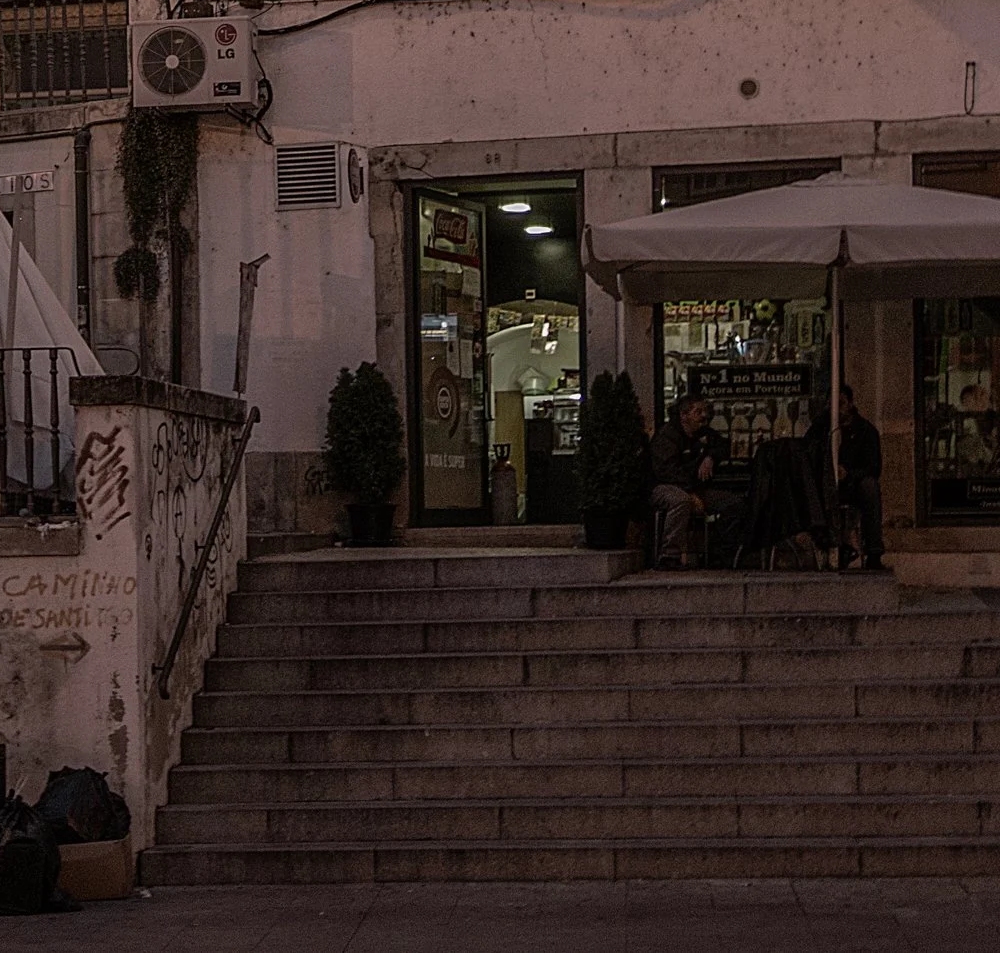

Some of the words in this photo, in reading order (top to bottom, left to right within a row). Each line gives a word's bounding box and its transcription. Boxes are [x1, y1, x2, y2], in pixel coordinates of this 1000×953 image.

[217, 48, 235, 60] LG
[732, 374, 751, 384] no
[752, 370, 801, 383] Mundo
[699, 384, 734, 396] Agora
[735, 385, 752, 394] em
[754, 383, 802, 395] Portugal
